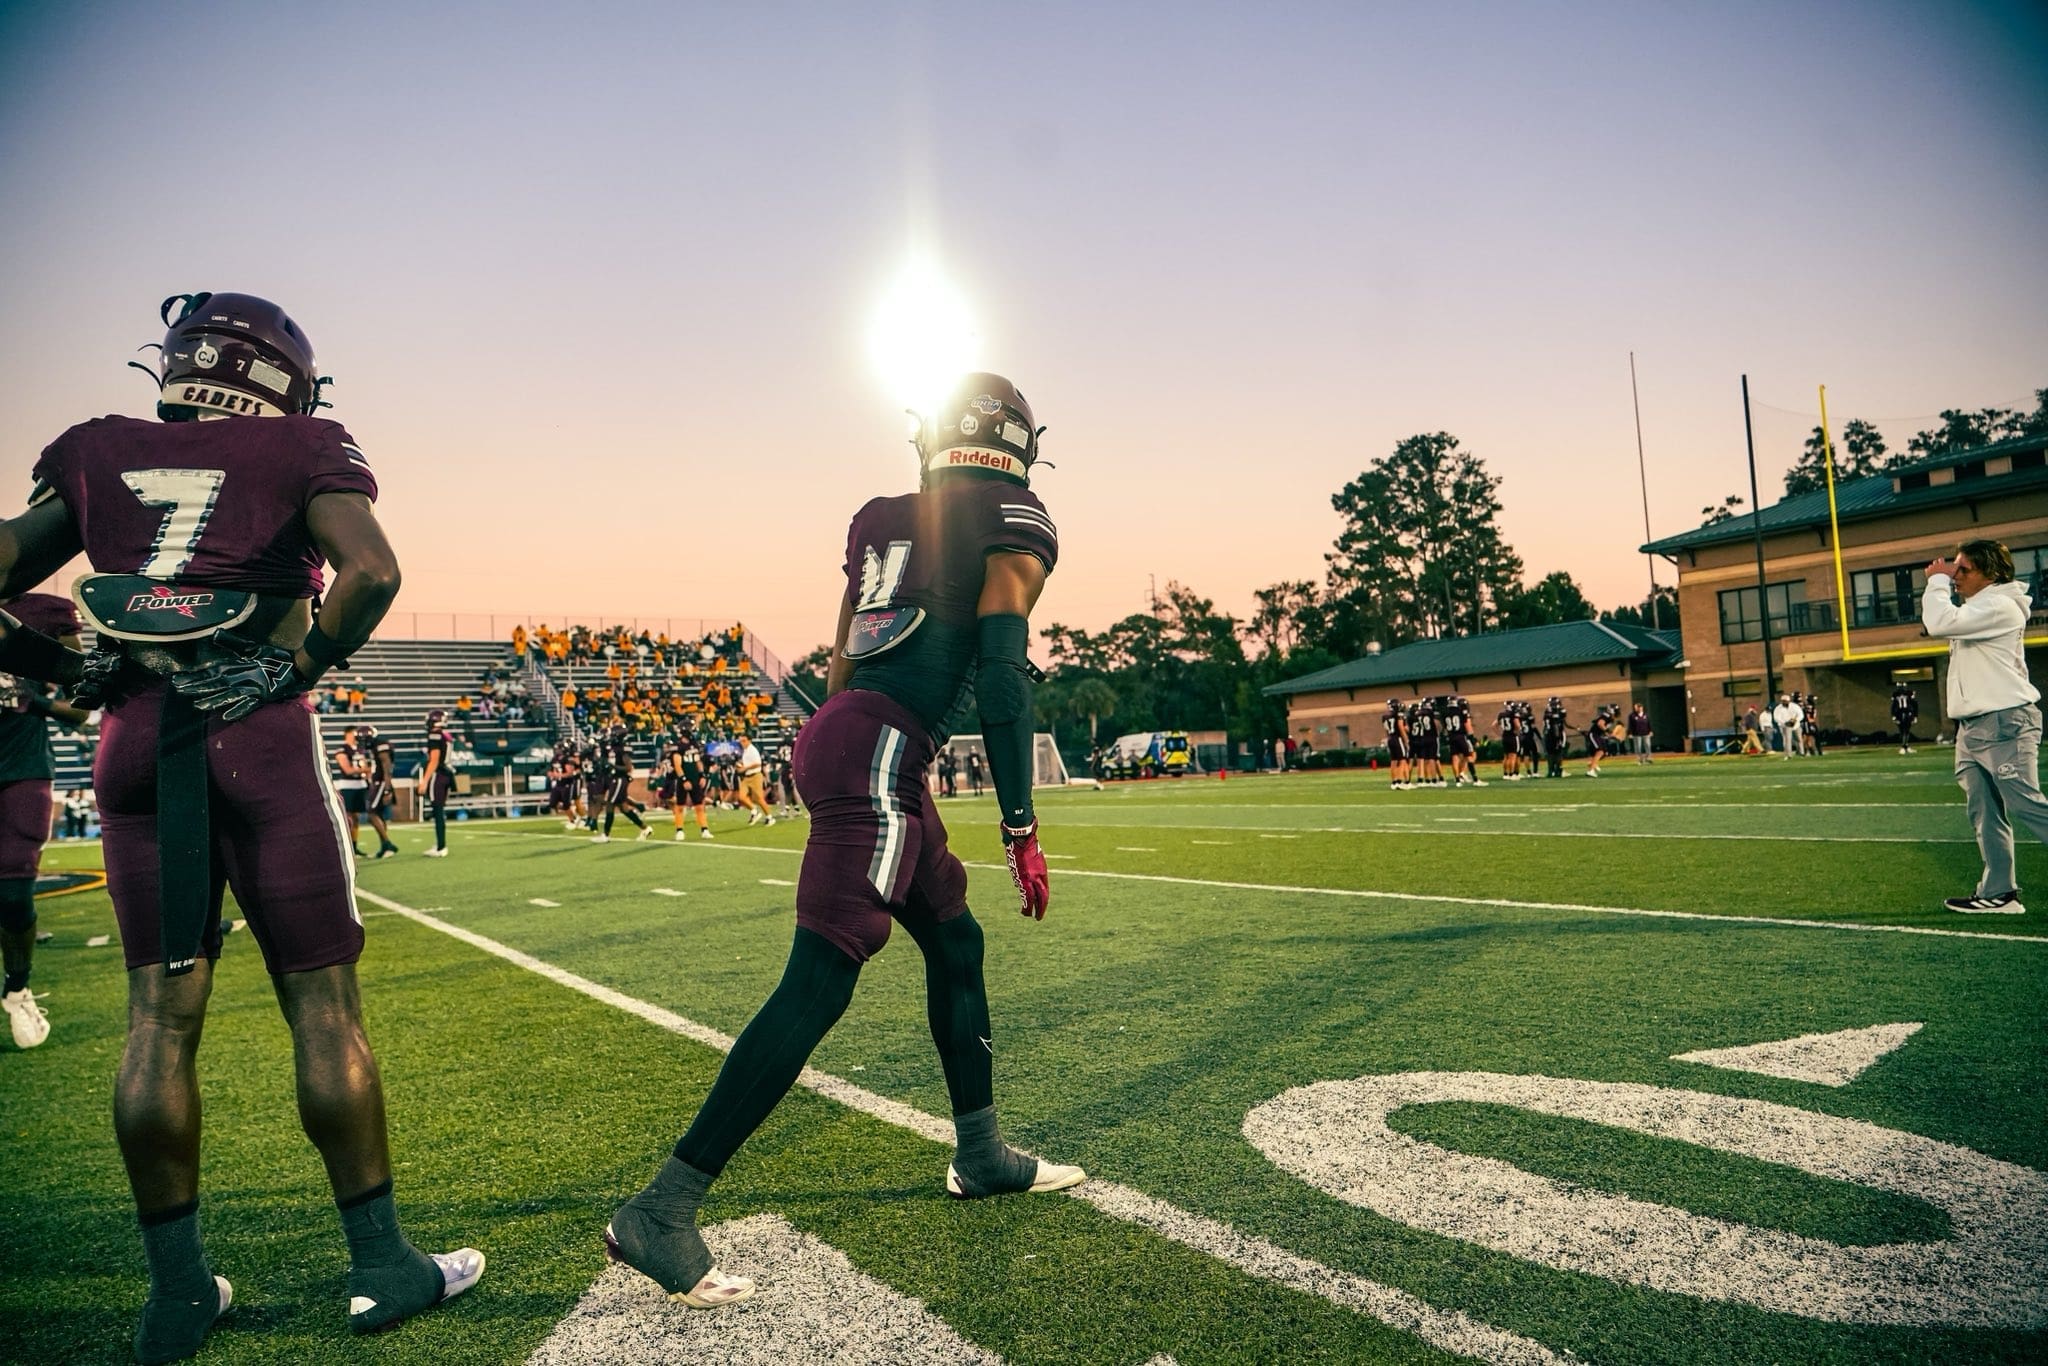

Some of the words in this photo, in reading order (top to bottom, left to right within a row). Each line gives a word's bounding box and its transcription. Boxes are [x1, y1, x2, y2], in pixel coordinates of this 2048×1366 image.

[198, 351, 215, 364] CJ
[237, 359, 246, 371] 7
[183, 386, 264, 416] CADETS
[962, 420, 976, 431] CJ
[949, 450, 1012, 471] Riddell
[120, 468, 226, 580] 7
